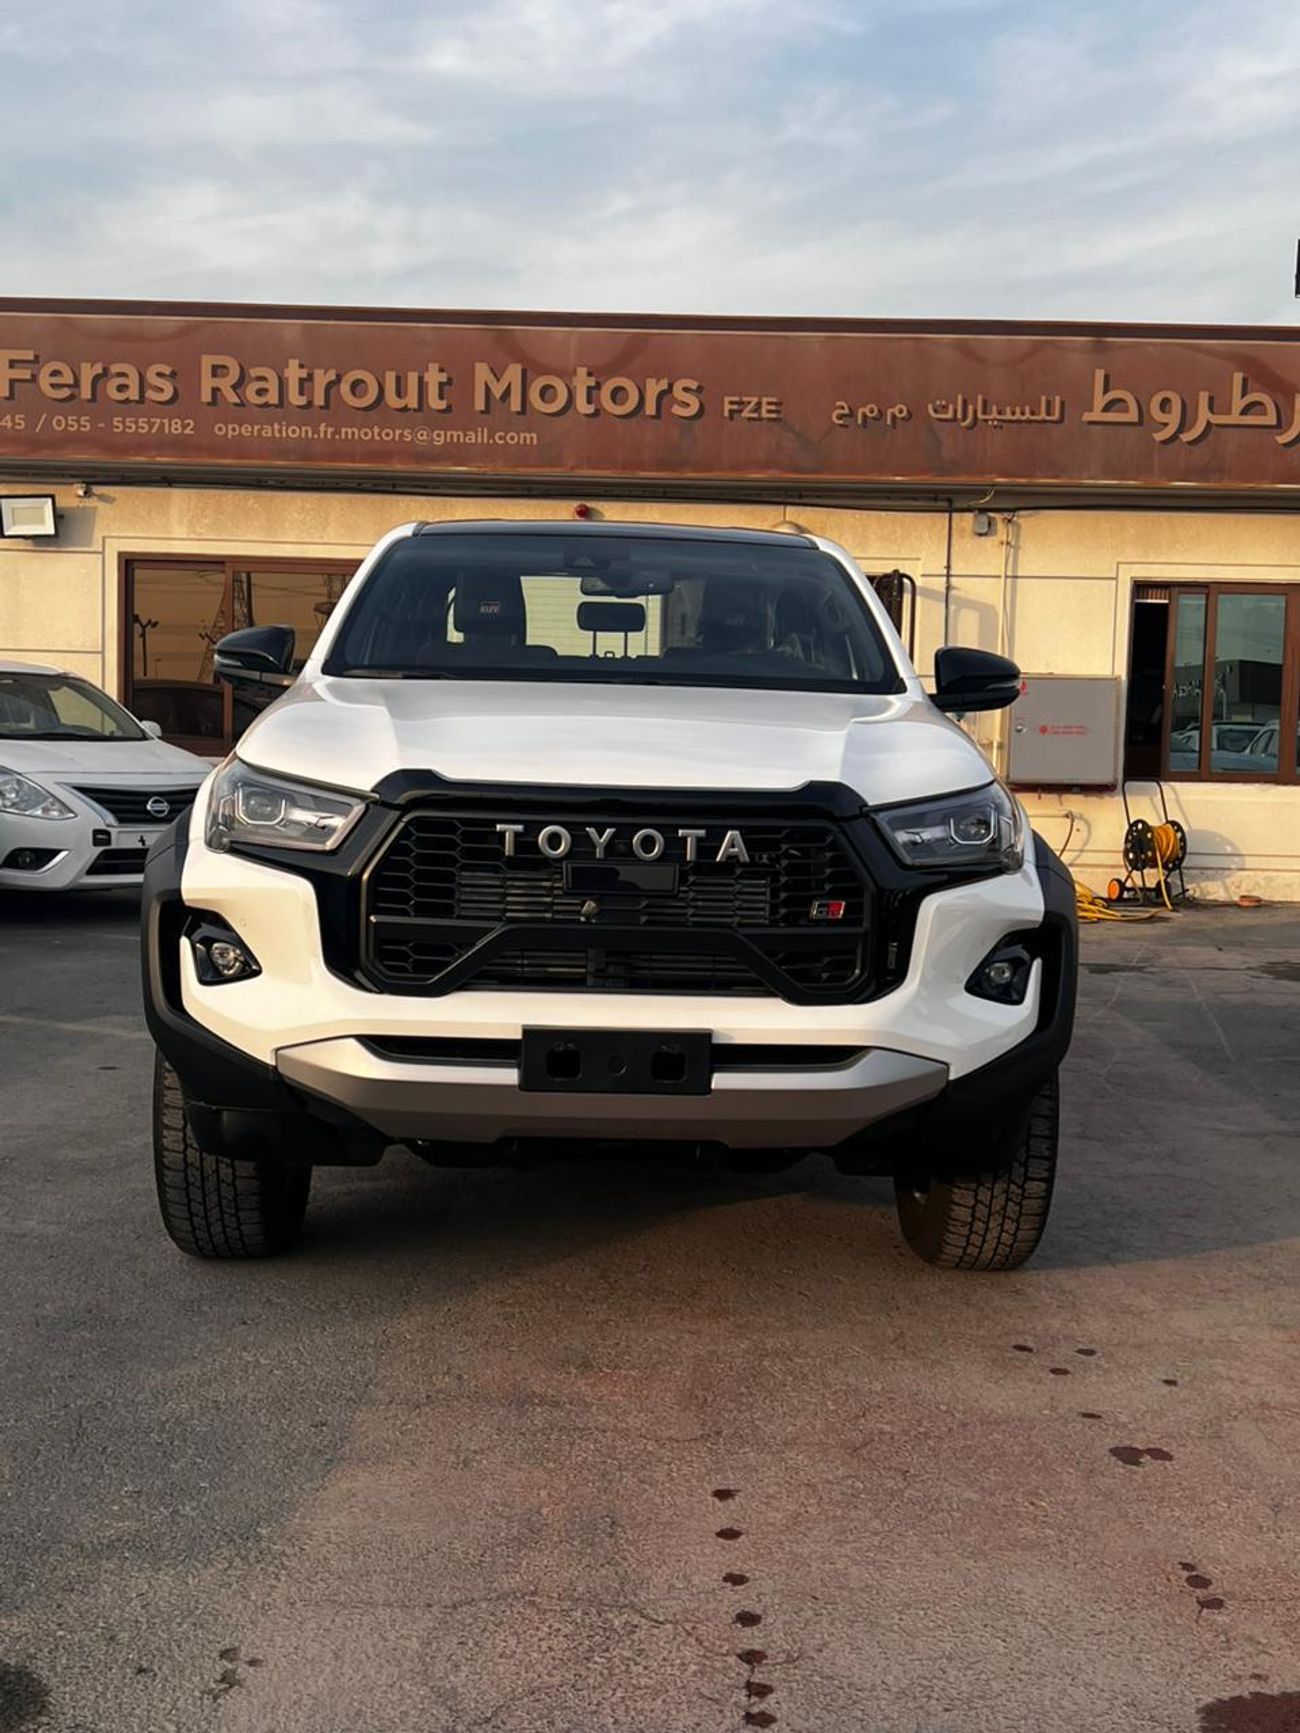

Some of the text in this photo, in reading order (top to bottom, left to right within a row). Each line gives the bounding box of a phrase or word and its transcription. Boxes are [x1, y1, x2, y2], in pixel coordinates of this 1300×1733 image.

[0, 349, 781, 419] Feras Ratrout Motors FZE
[928, 394, 1061, 427] للسيارات
[52, 415, 91, 432] 055
[112, 417, 195, 434] 5557182
[214, 422, 538, 446] operation.fr.motors@gmail.com
[496, 824, 750, 862] TOYOTA
